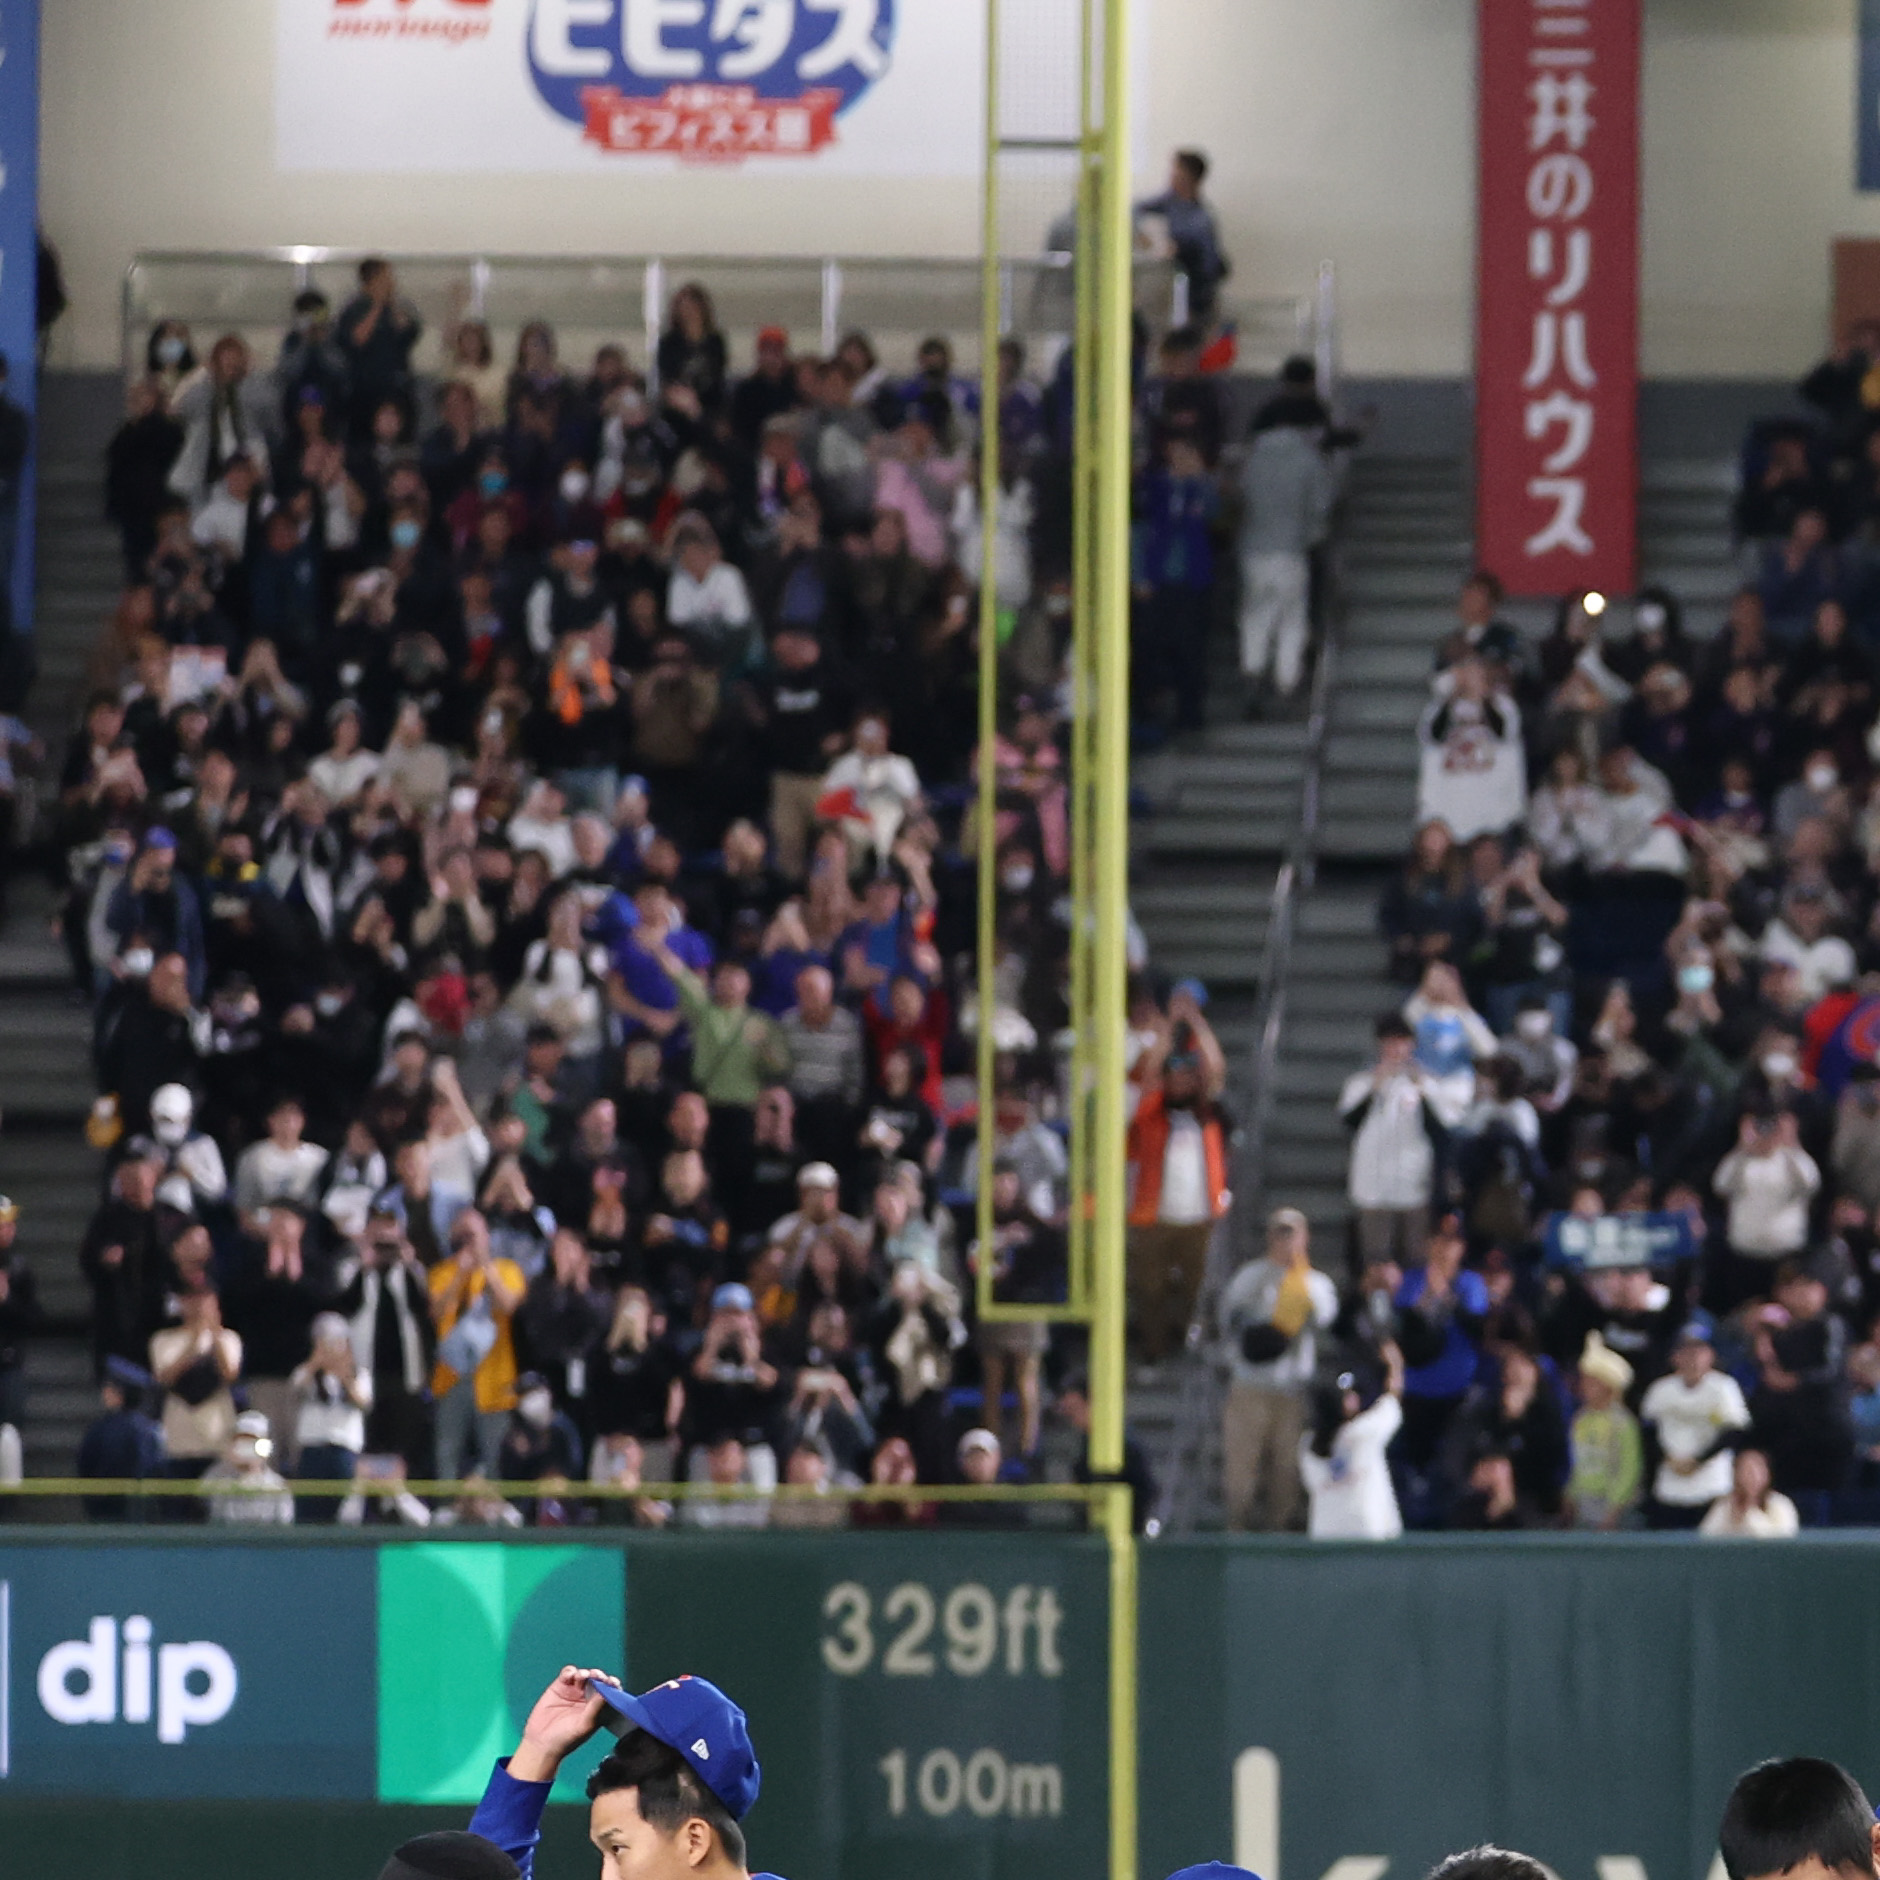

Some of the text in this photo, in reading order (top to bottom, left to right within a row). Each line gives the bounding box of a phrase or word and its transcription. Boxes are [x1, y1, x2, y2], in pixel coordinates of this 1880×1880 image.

[1524, 0, 1598, 556] 三井のリハウス
[36, 1616, 238, 1745] dip
[822, 1582, 1063, 1678] 329ft
[880, 1749, 1062, 1818] 100m
